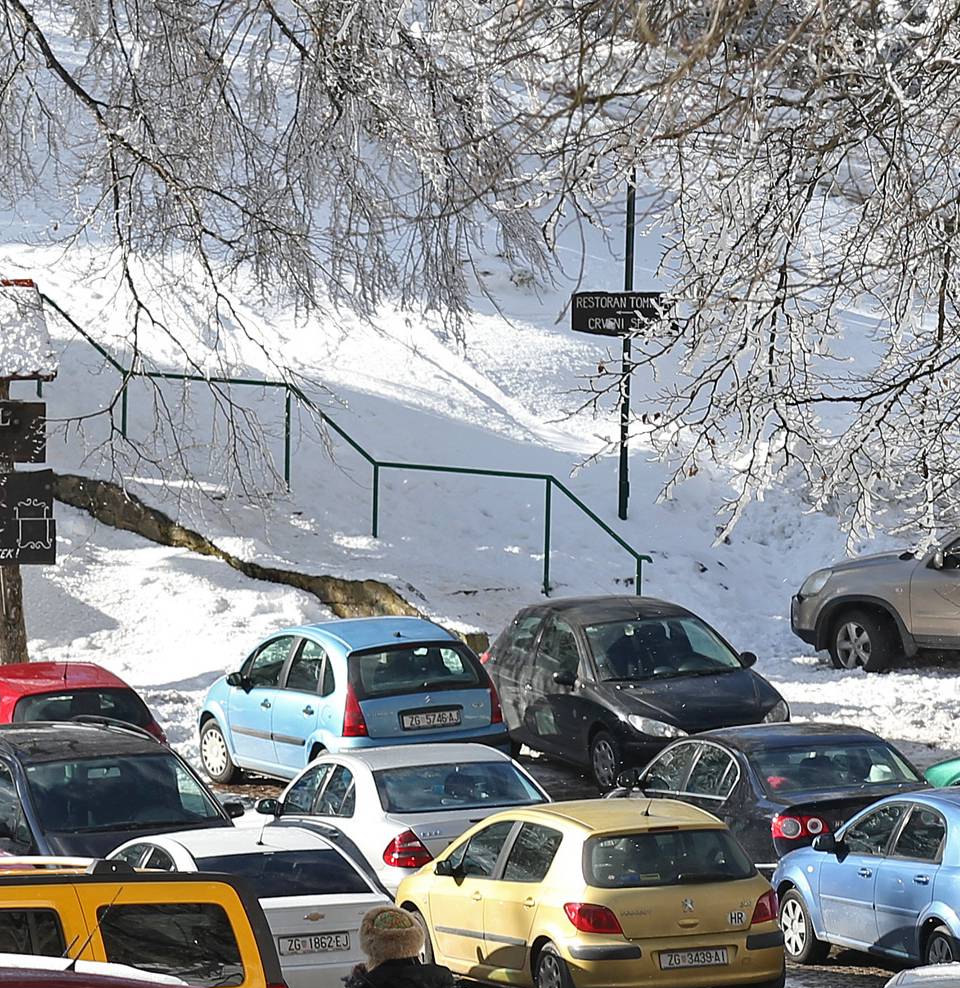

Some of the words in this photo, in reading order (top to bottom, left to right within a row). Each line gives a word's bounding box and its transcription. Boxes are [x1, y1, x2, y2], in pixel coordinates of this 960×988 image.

[576, 296, 627, 309] RESTORAN
[408, 715, 421, 727] ZG
[729, 911, 745, 925] HR
[287, 938, 301, 952] ZG
[667, 953, 681, 966] ZG
